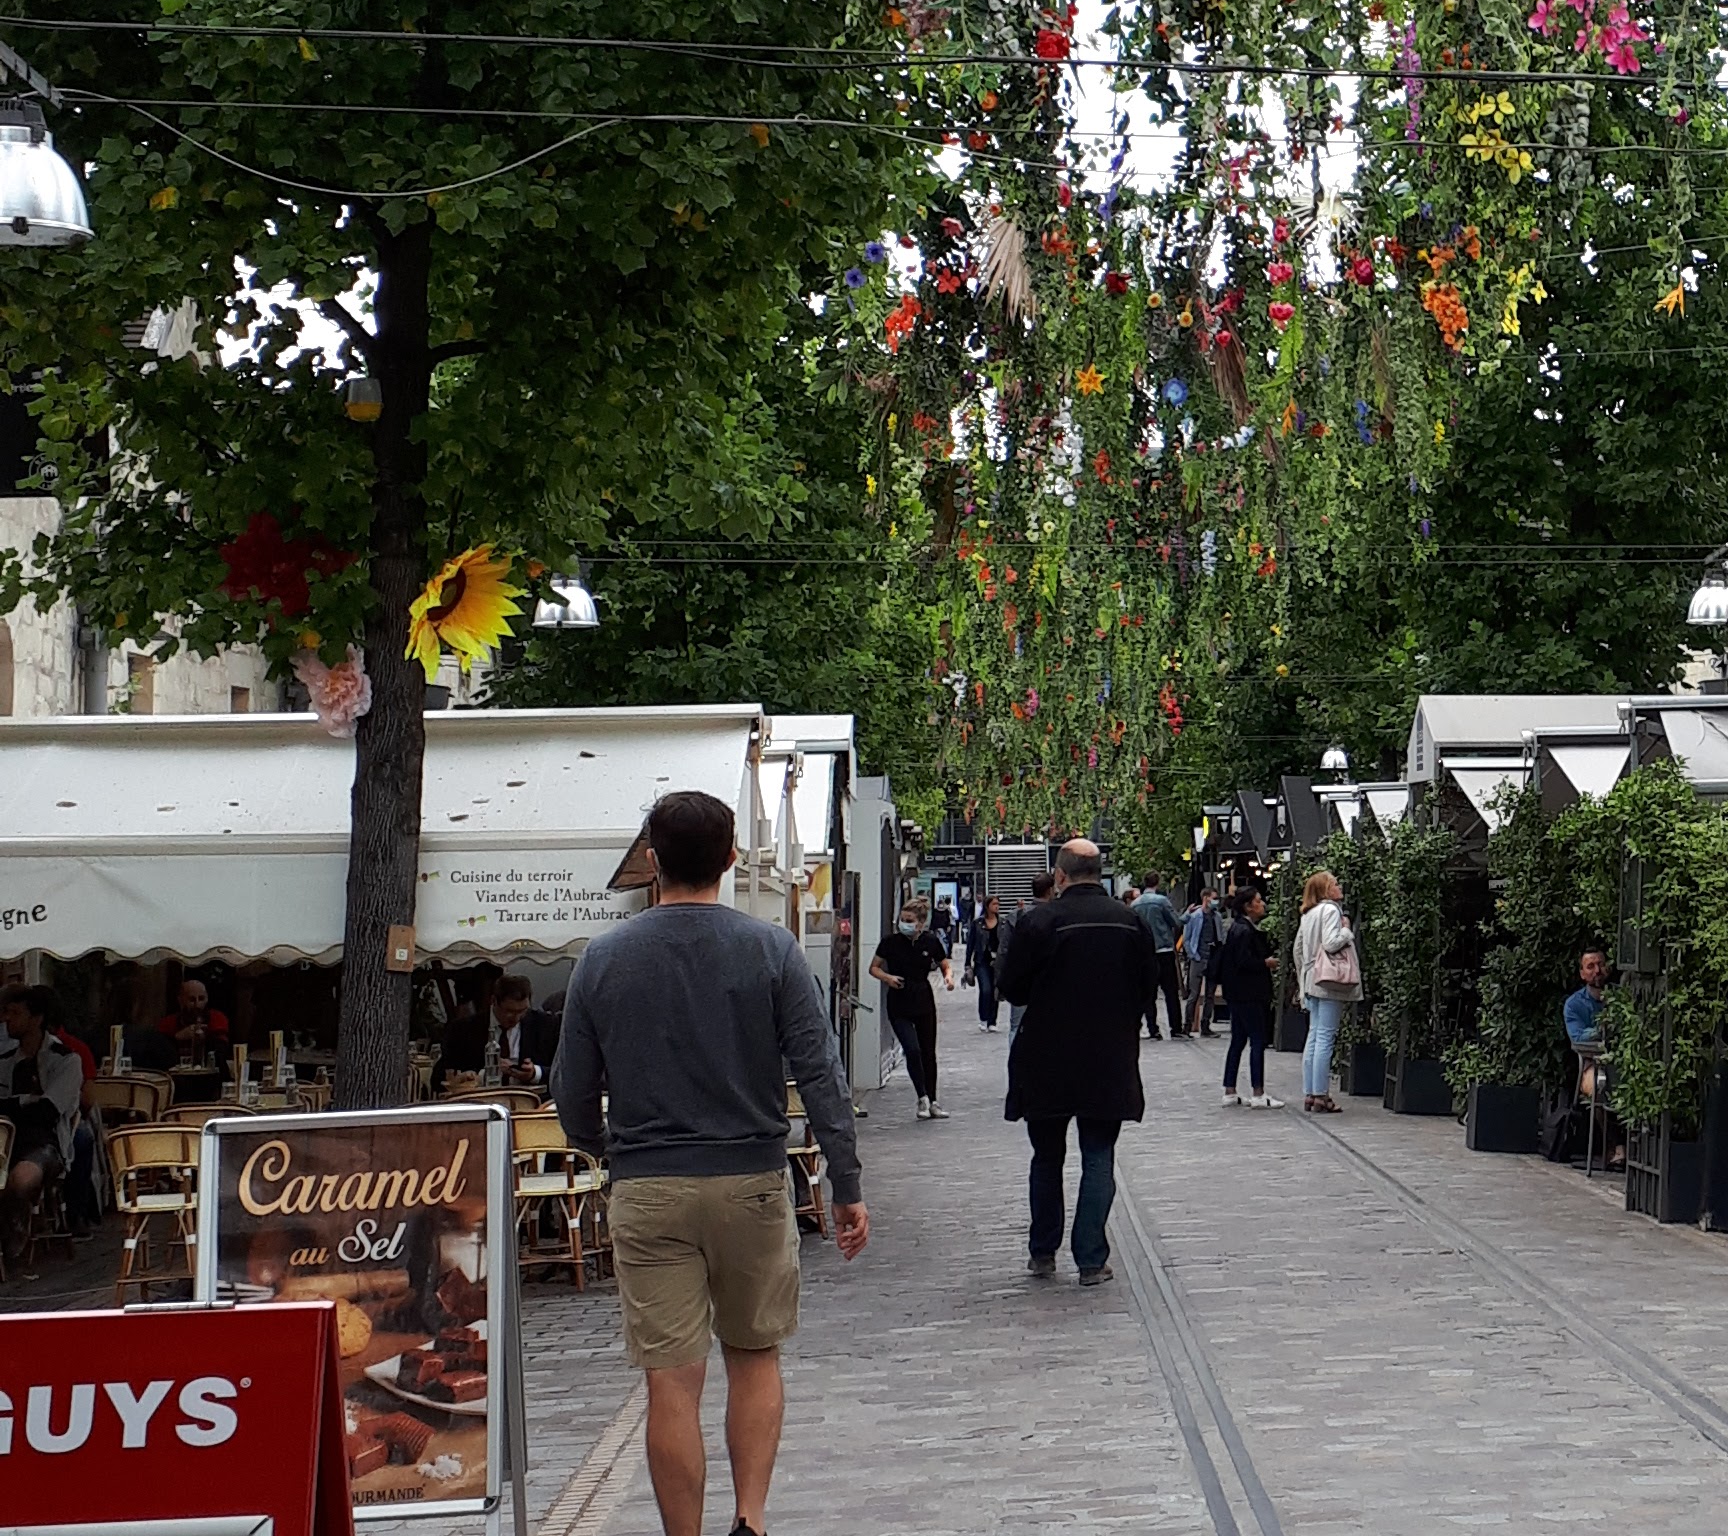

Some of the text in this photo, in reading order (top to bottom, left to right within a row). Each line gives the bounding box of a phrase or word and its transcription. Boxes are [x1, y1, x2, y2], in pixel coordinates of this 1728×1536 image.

[450, 869, 574, 884] Cuisine du terroir
[474, 888, 612, 904] Viandes de l'Aubrac
[0, 904, 48, 931] gne
[494, 907, 631, 923] Tartare de l'Aubrac
[238, 1138, 470, 1216] Caramel
[289, 1218, 407, 1266] au Sel
[0, 1376, 238, 1454] UYS
